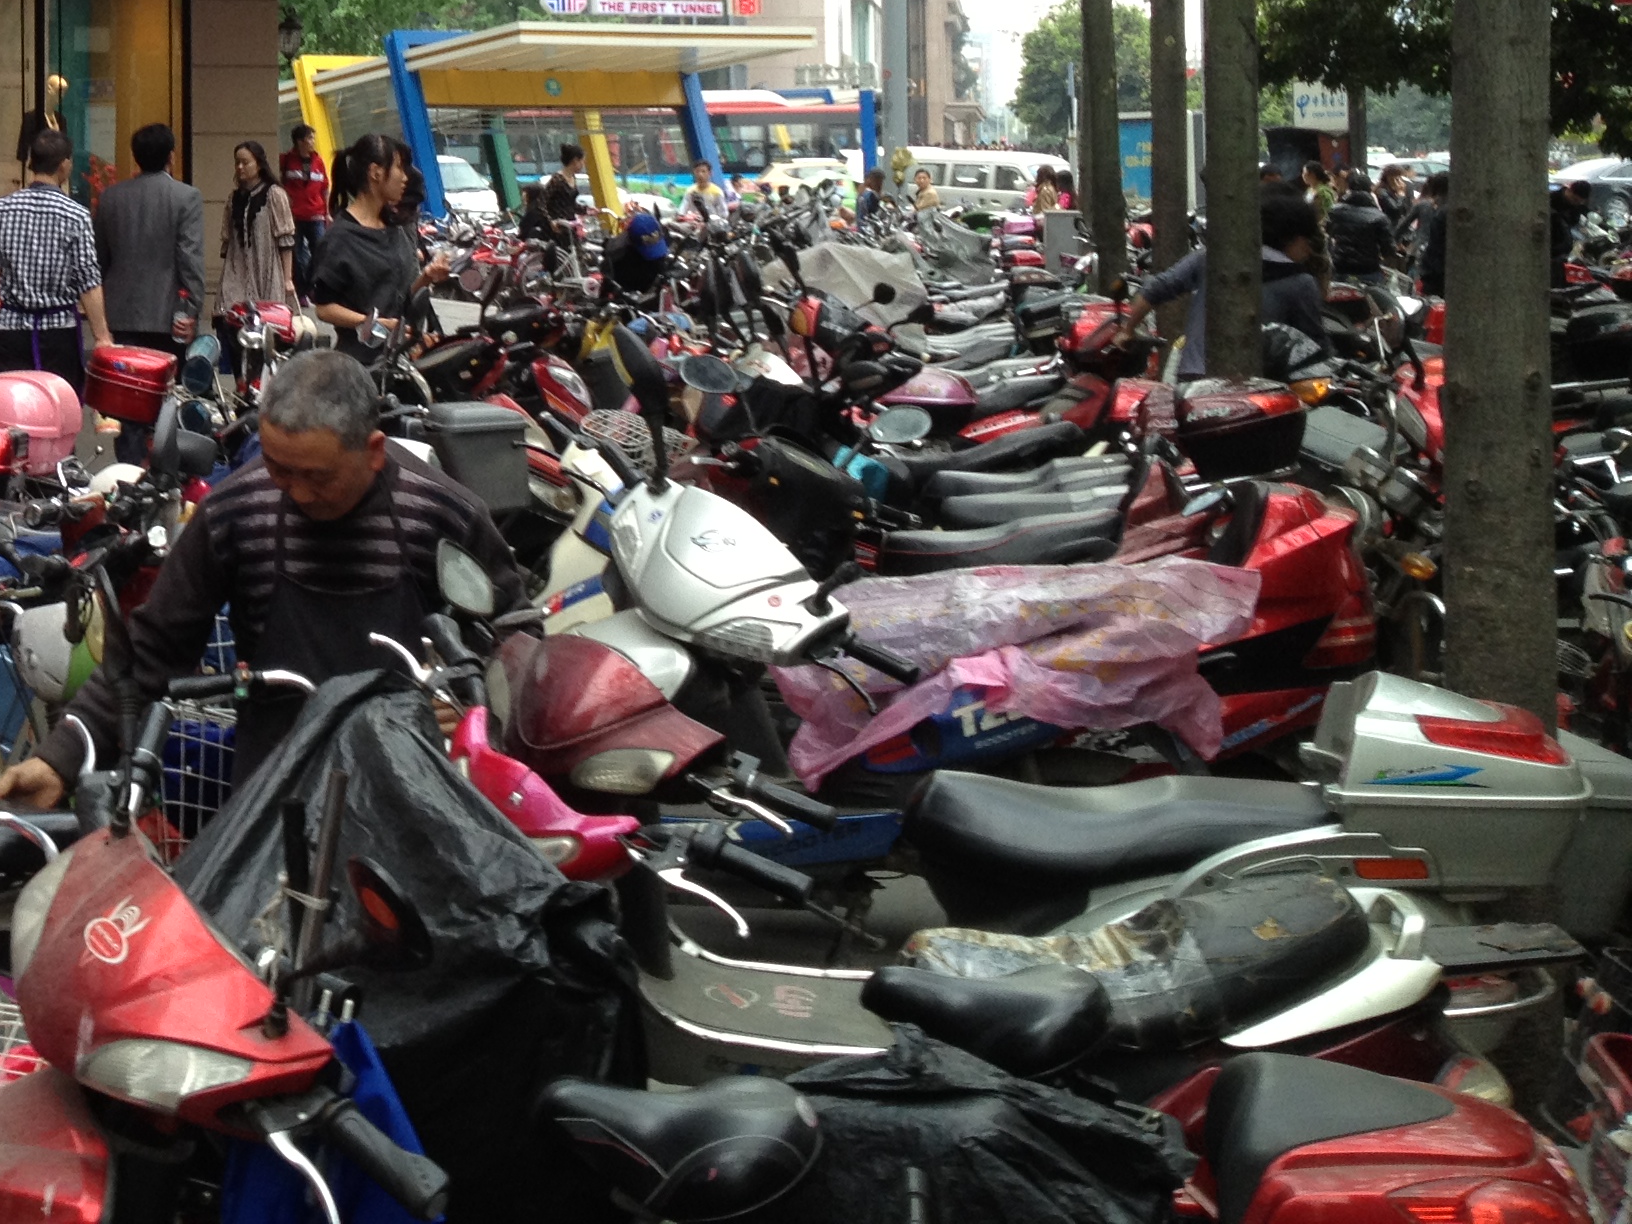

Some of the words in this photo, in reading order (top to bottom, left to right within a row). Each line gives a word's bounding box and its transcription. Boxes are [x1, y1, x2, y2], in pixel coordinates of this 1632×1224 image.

[599, 1, 625, 13] THE
[629, 2, 666, 14] FIRST
[672, 3, 721, 15] TUNNEL
